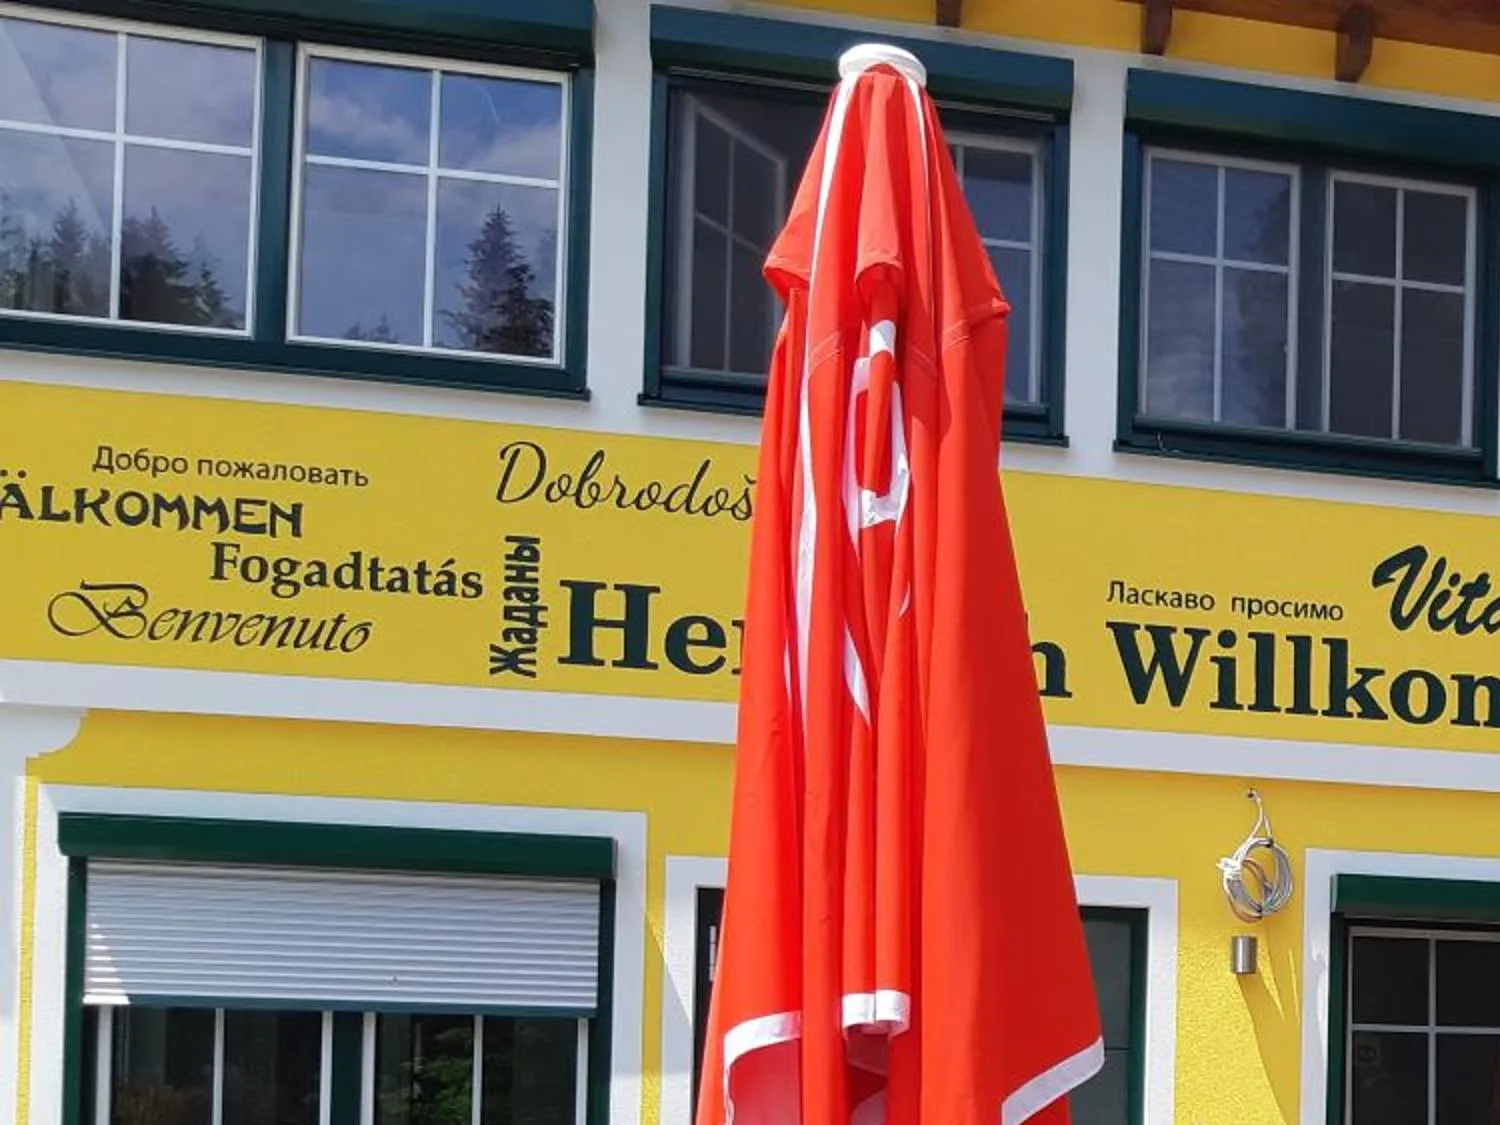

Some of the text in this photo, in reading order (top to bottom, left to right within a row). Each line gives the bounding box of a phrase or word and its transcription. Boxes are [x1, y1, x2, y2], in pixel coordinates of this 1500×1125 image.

[92, 445, 369, 487] Добро пожаловать
[496, 441, 757, 520] Dobrodoš
[0, 468, 306, 538] ÄLKOMMEN
[210, 541, 483, 599] Fogadtatás
[1107, 580, 1343, 621] Ласкаво просимо
[48, 578, 373, 653] Benvenuto
[490, 535, 548, 679] Жаданы
